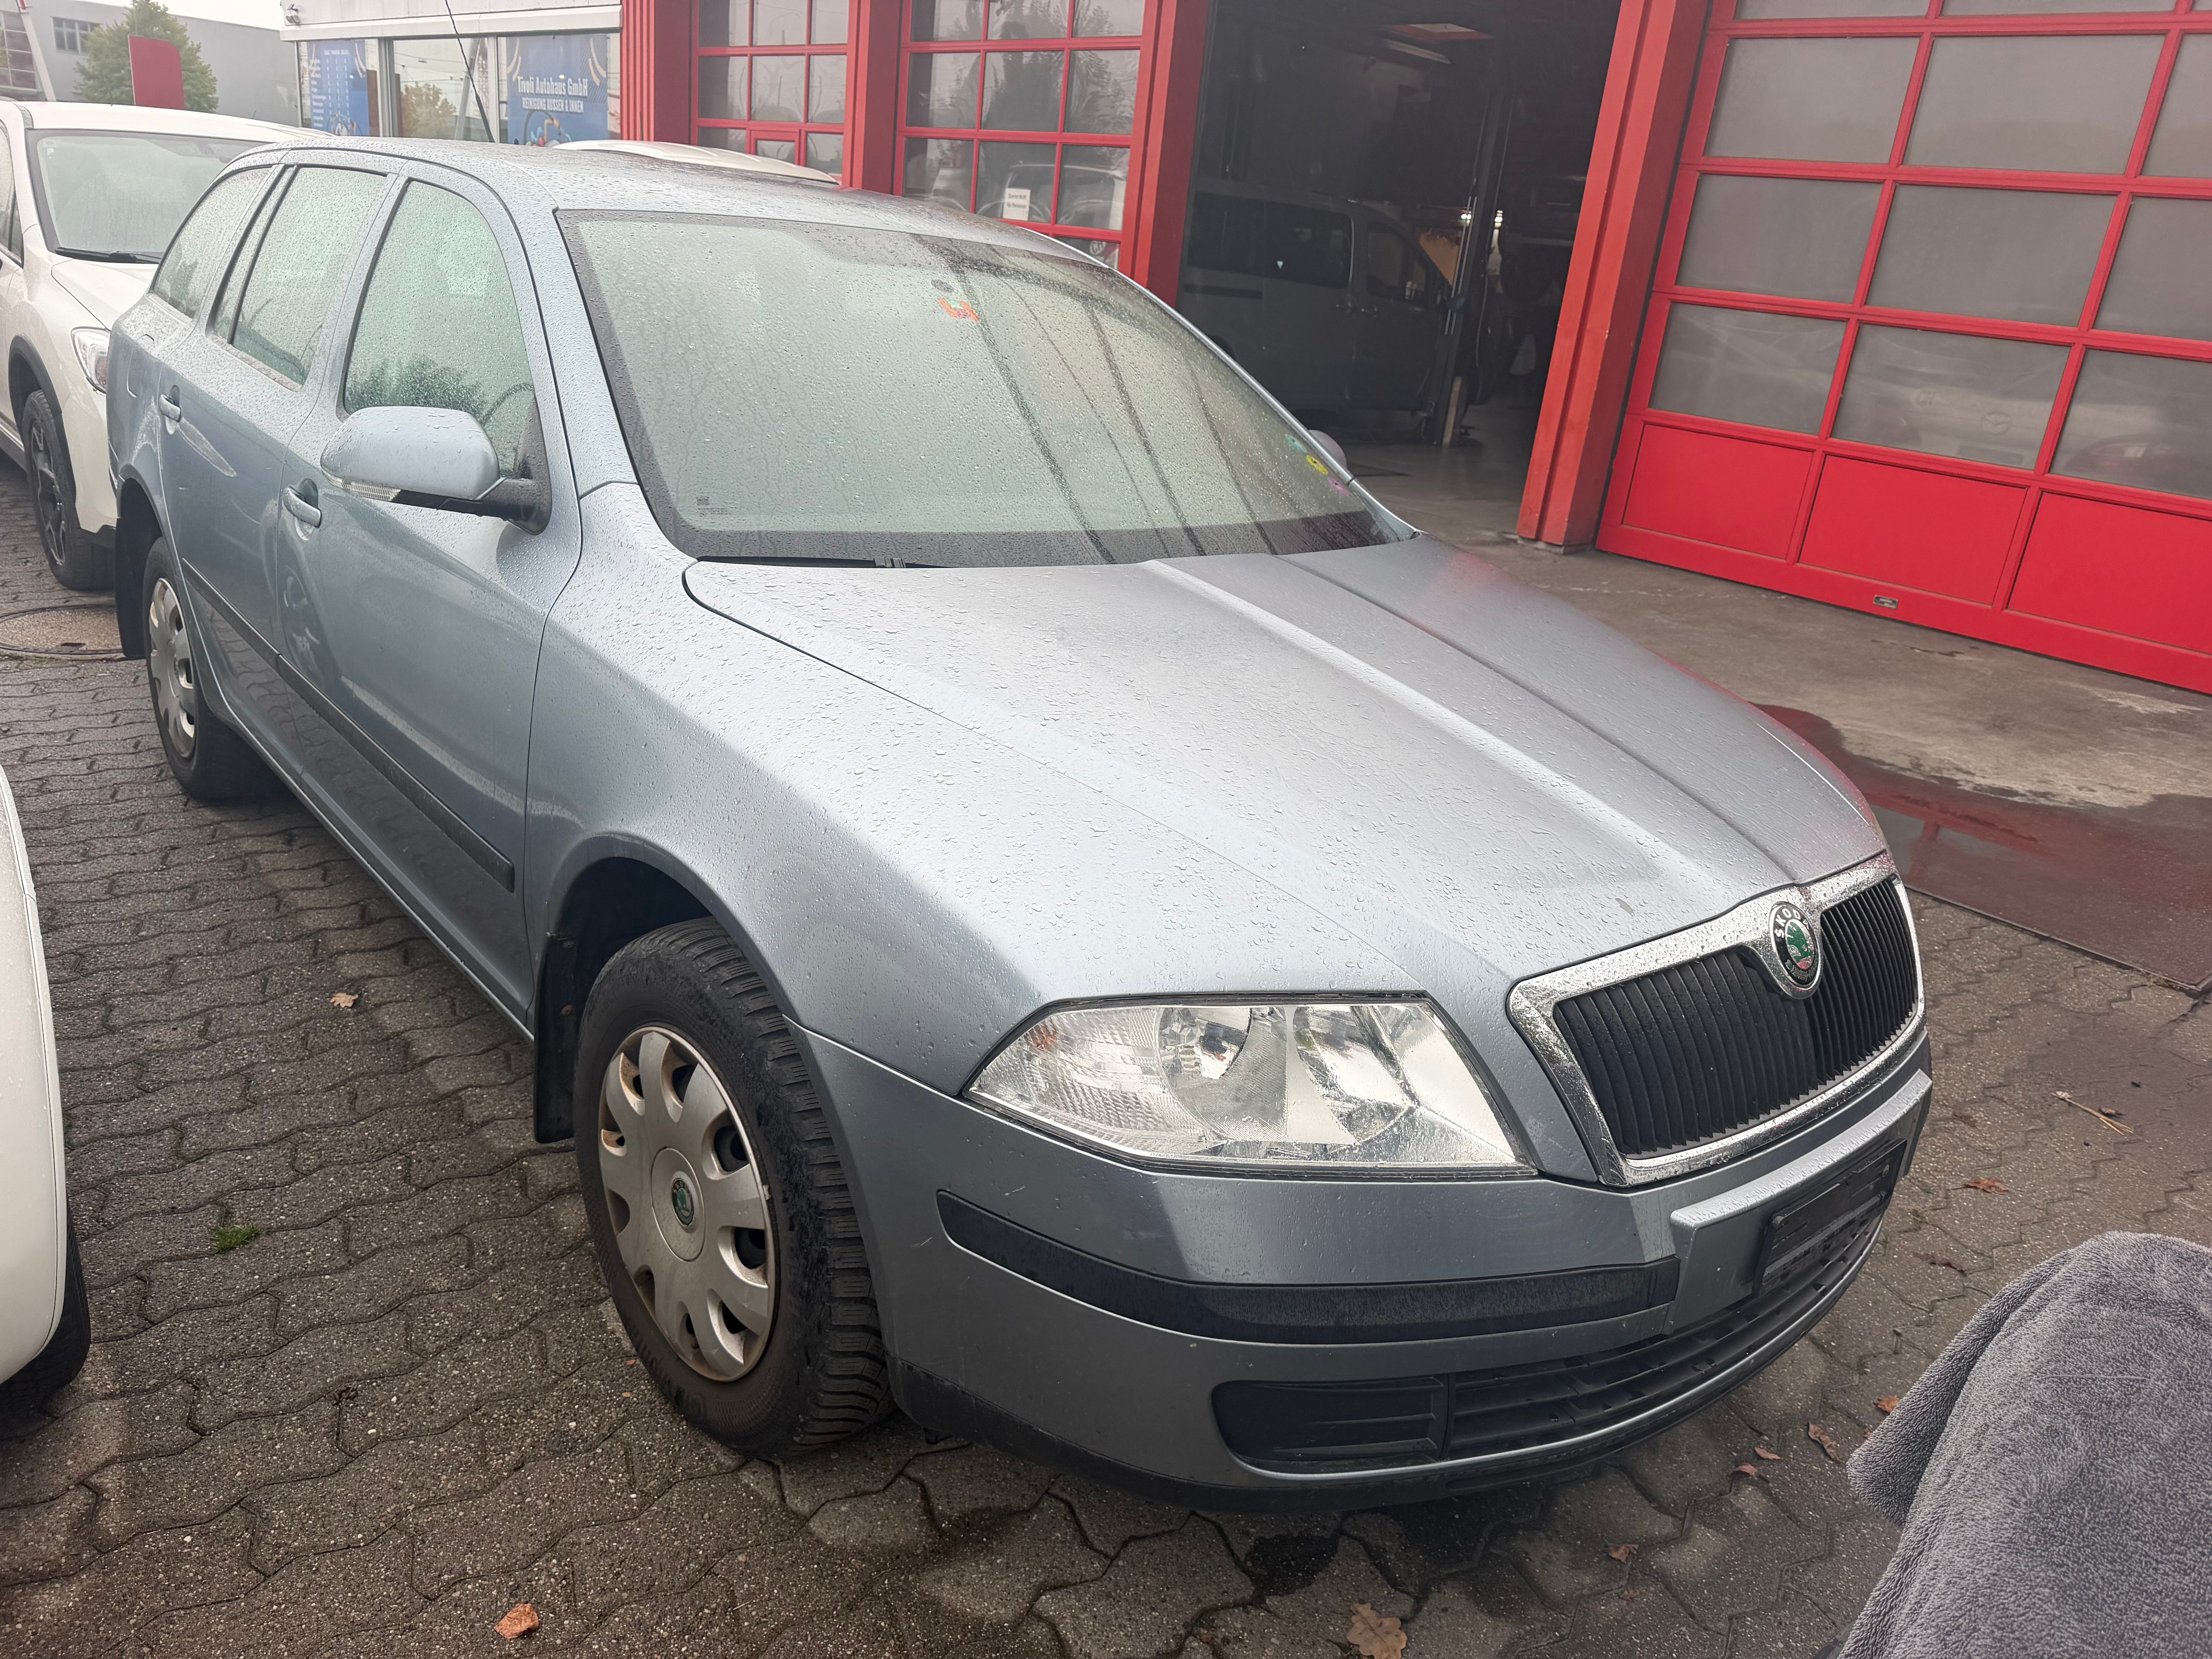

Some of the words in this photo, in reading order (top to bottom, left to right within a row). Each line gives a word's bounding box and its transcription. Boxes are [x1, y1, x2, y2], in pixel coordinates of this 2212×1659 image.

[517, 76, 534, 93] Tivoli
[535, 77, 566, 95] Autohaus
[568, 77, 588, 96] GmbH
